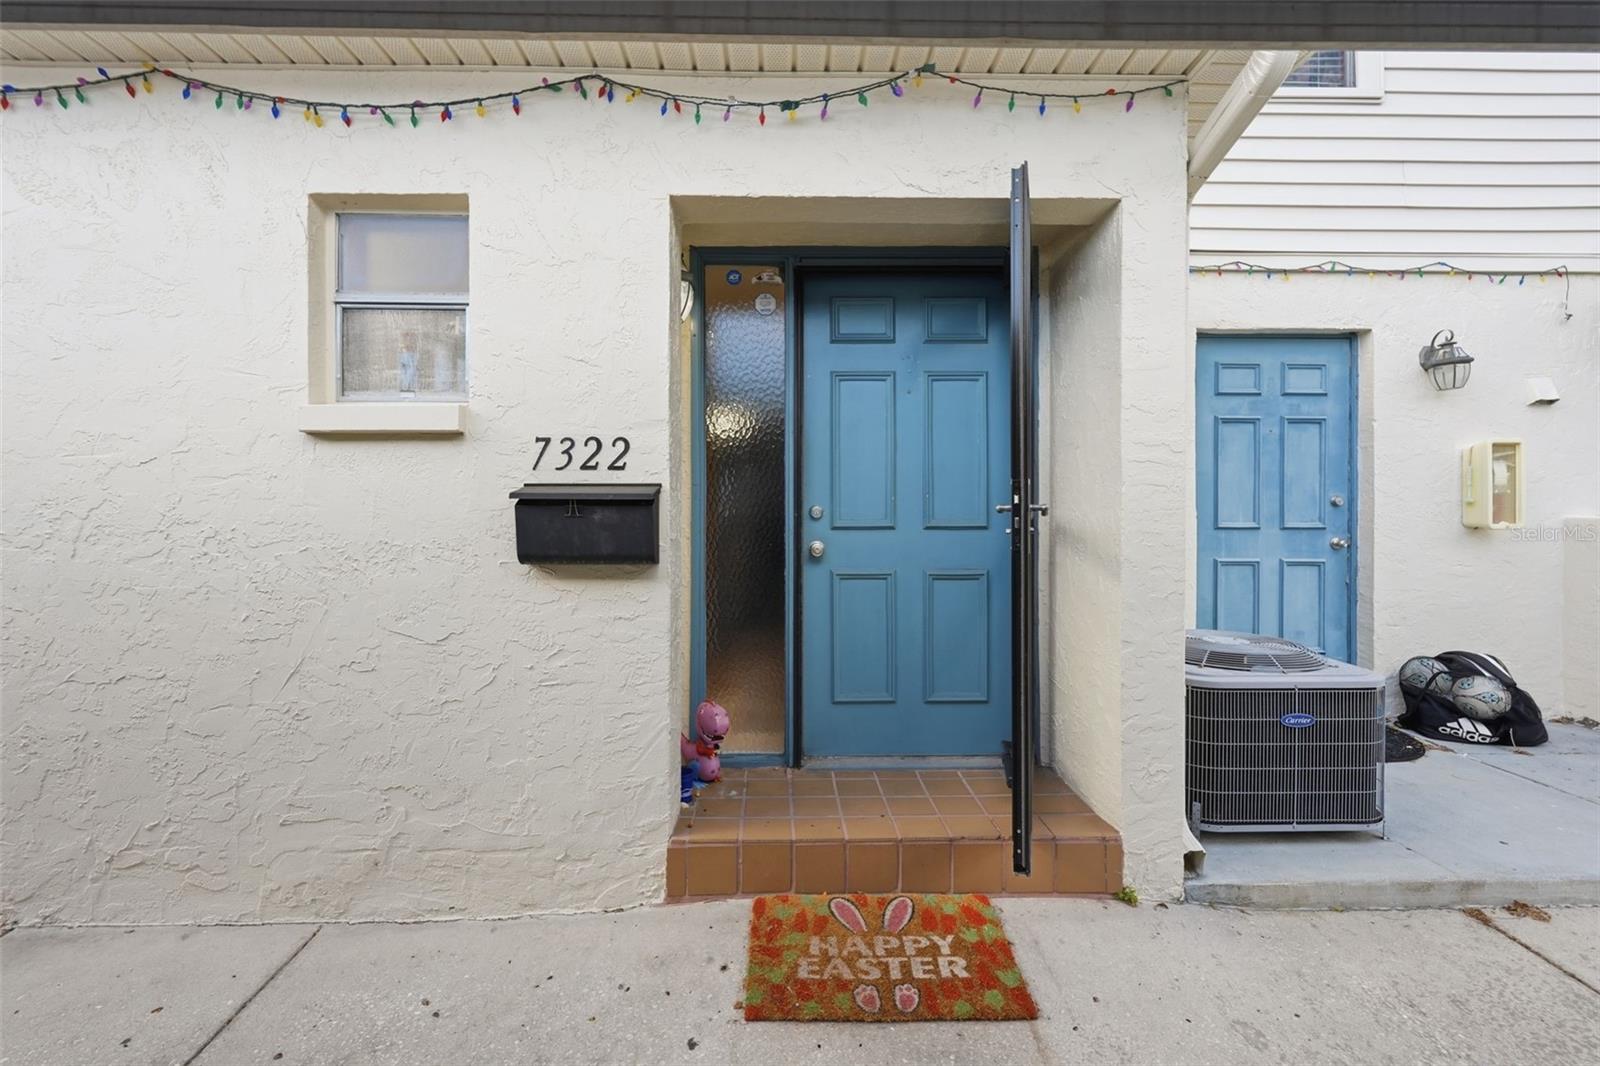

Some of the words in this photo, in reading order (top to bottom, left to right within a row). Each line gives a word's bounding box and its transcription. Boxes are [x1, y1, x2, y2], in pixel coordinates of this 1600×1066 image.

[532, 436, 631, 471] 7322
[1285, 716, 1312, 724] Carrier
[808, 935, 955, 956] HAPPY
[797, 956, 971, 979] EASTER
